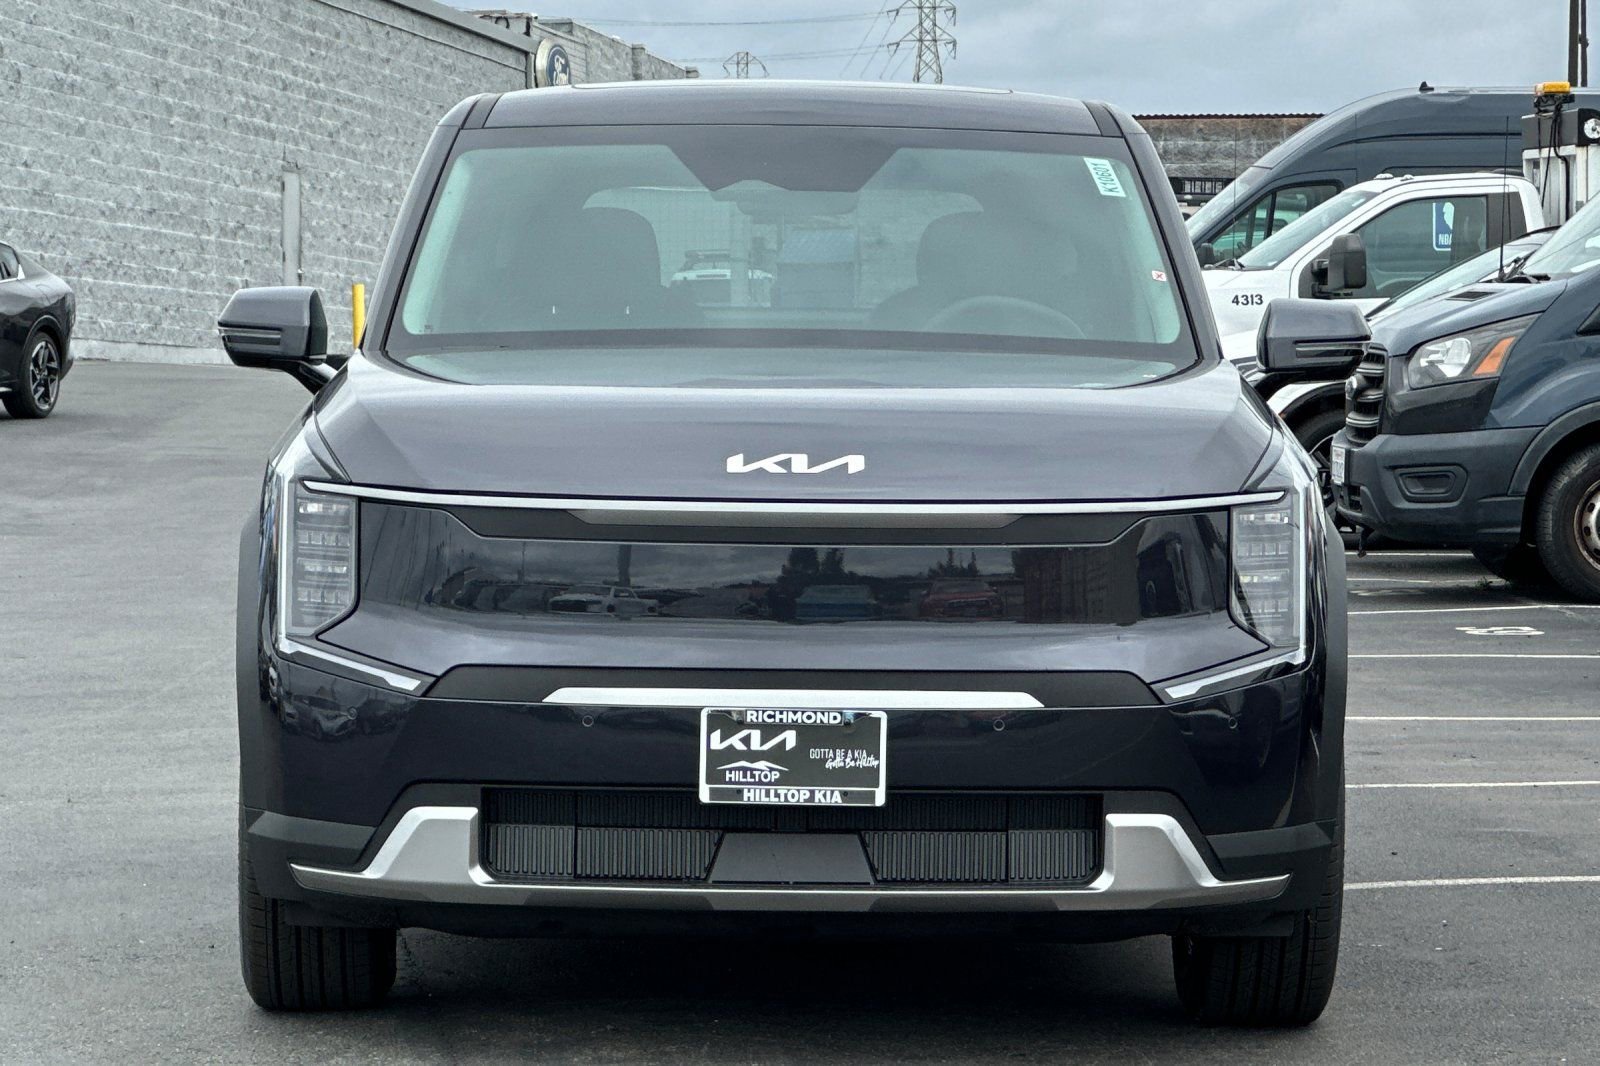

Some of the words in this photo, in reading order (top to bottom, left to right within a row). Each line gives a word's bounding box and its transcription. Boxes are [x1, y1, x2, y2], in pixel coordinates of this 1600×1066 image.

[553, 54, 569, 86] Ford
[1090, 162, 1121, 193] K10601
[1231, 293, 1264, 306] 4313
[726, 453, 865, 475] KIA
[746, 710, 842, 725] RICHMOND
[710, 728, 797, 752] KIA
[809, 748, 834, 759] GOTTA
[835, 748, 846, 759] BE
[846, 749, 853, 759] A
[854, 749, 868, 759] KIA
[725, 770, 780, 783] HILLTOP
[743, 788, 810, 803] HILLTOP
[814, 789, 843, 804] KIA
